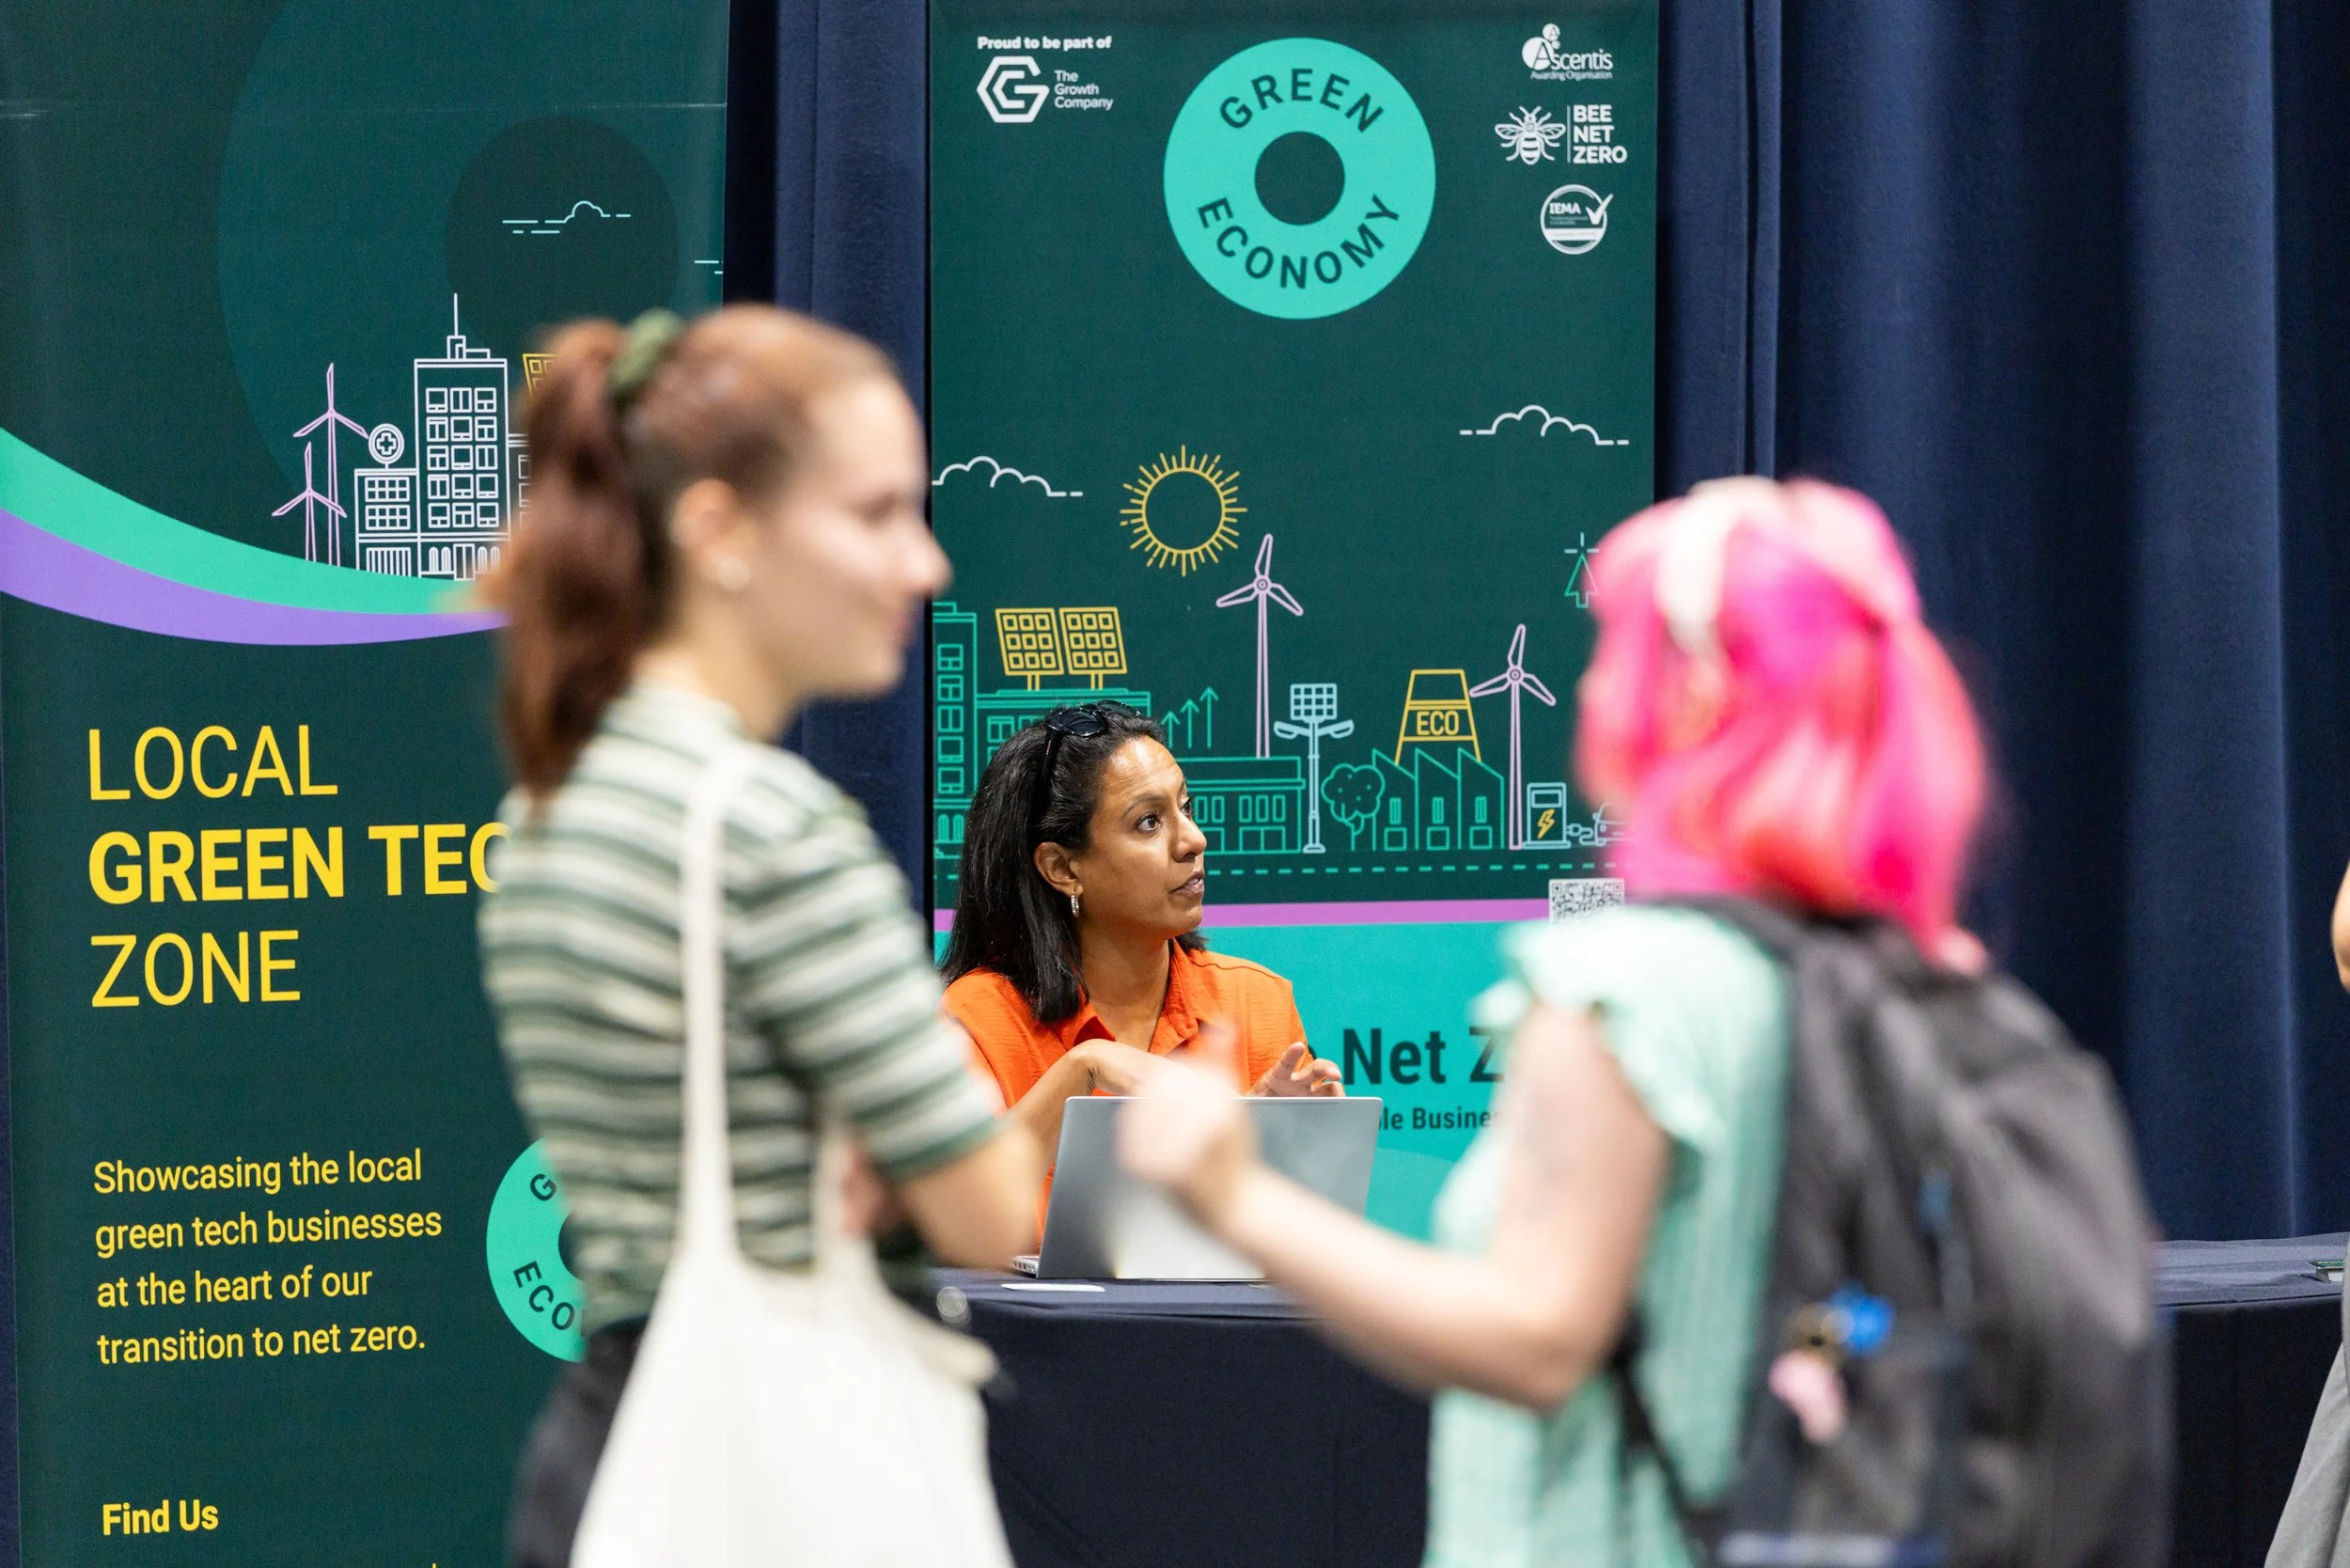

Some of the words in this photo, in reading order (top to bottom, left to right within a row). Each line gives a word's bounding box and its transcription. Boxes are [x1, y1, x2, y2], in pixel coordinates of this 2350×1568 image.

[977, 36, 1022, 50] Proud
[1024, 37, 1041, 49] to
[1042, 36, 1061, 49] be
[1063, 36, 1094, 52] part
[1096, 35, 1113, 49] of
[1532, 41, 1614, 71] Ascentis
[1054, 69, 1080, 83] The
[1054, 83, 1100, 96] Growth
[1054, 96, 1114, 111] Company
[1219, 68, 1385, 133] GREEN
[1573, 104, 1613, 123] BEE
[1573, 125, 1616, 144] NET
[1572, 145, 1629, 165] ZERO
[1197, 194, 1401, 290] ECONOMY
[1417, 710, 1460, 736] ECO
[89, 725, 338, 801] LOCAL
[89, 826, 344, 905] GREEN
[368, 821, 510, 896] TEC
[91, 930, 301, 1008] ZONE
[1342, 1027, 1447, 1085] Net
[94, 1156, 281, 1195] Showcasing
[290, 1152, 339, 1186] the
[349, 1148, 422, 1184] local
[95, 1223, 184, 1259] green
[192, 1212, 258, 1247] tech
[267, 1209, 443, 1244] businesses
[97, 1278, 129, 1308] at
[137, 1273, 186, 1306] the
[195, 1269, 273, 1303] heart
[282, 1264, 314, 1299] of
[321, 1269, 373, 1297] our
[97, 1328, 243, 1365] transition
[253, 1328, 284, 1357] to
[292, 1325, 341, 1355] net
[350, 1324, 426, 1353] zero.
[102, 1499, 170, 1536] Find
[179, 1499, 219, 1531] Us
